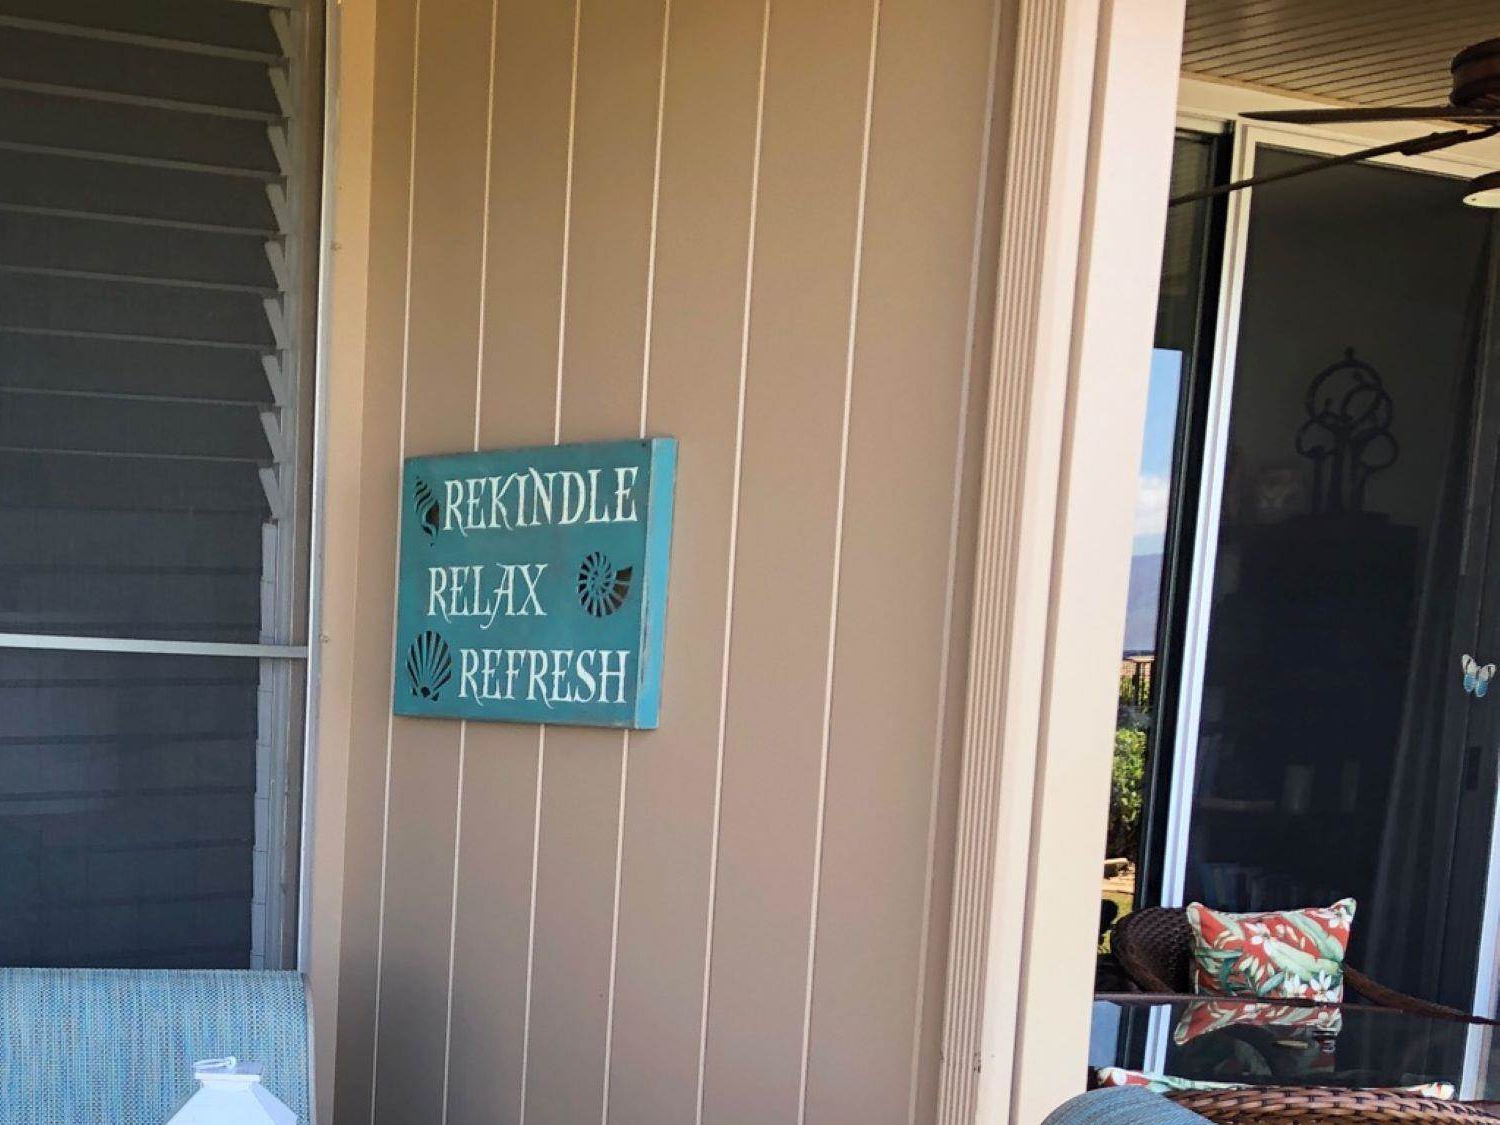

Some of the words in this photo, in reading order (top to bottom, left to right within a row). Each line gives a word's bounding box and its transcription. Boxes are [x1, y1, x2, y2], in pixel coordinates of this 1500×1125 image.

[443, 466, 639, 537] REKINDLE
[426, 562, 548, 629] RELAX
[457, 648, 631, 709] REFRESH
